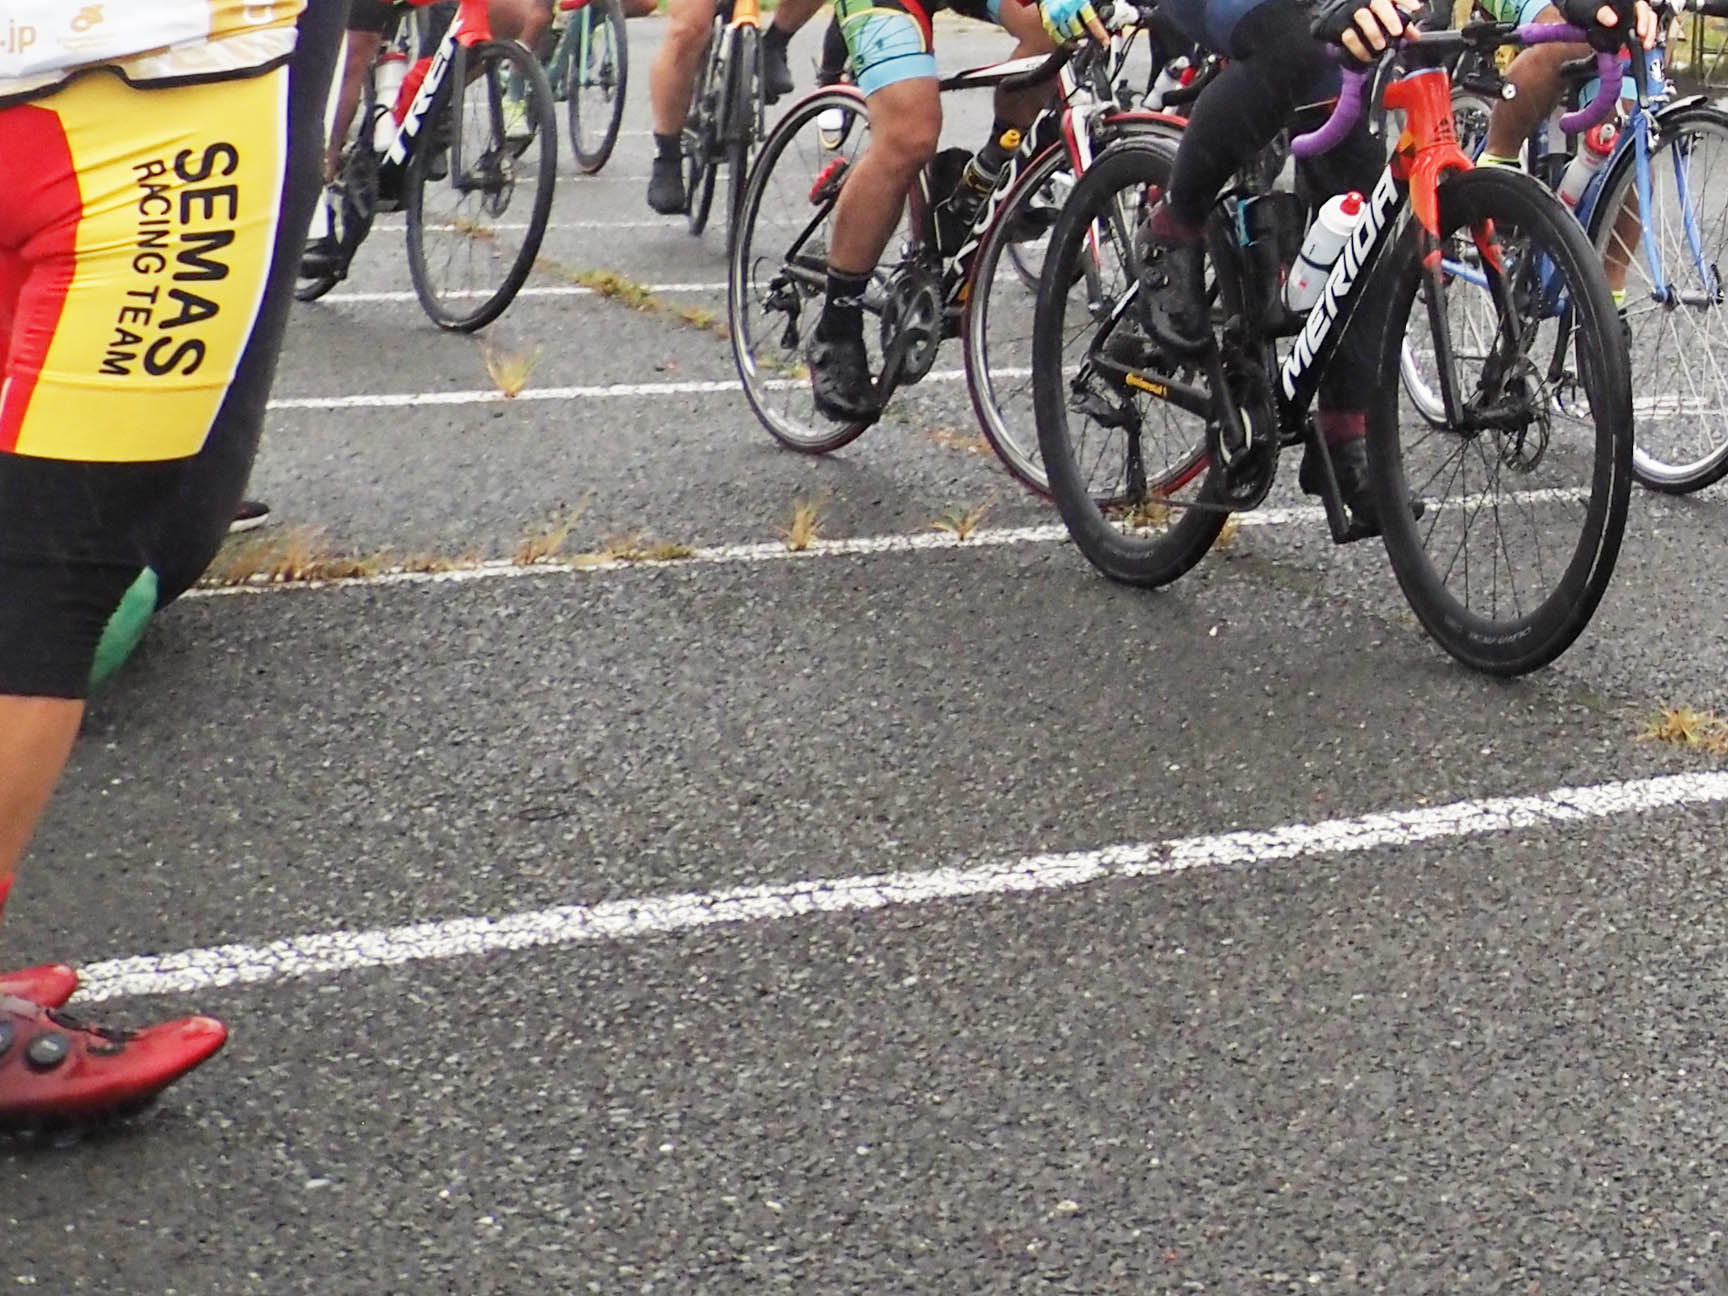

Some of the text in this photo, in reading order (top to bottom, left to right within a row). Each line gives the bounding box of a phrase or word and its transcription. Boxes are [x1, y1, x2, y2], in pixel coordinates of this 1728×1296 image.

[98, 159, 172, 376] RACING TEAM
[142, 141, 239, 377] SEMAS
[1281, 163, 1399, 402] MERIDA
